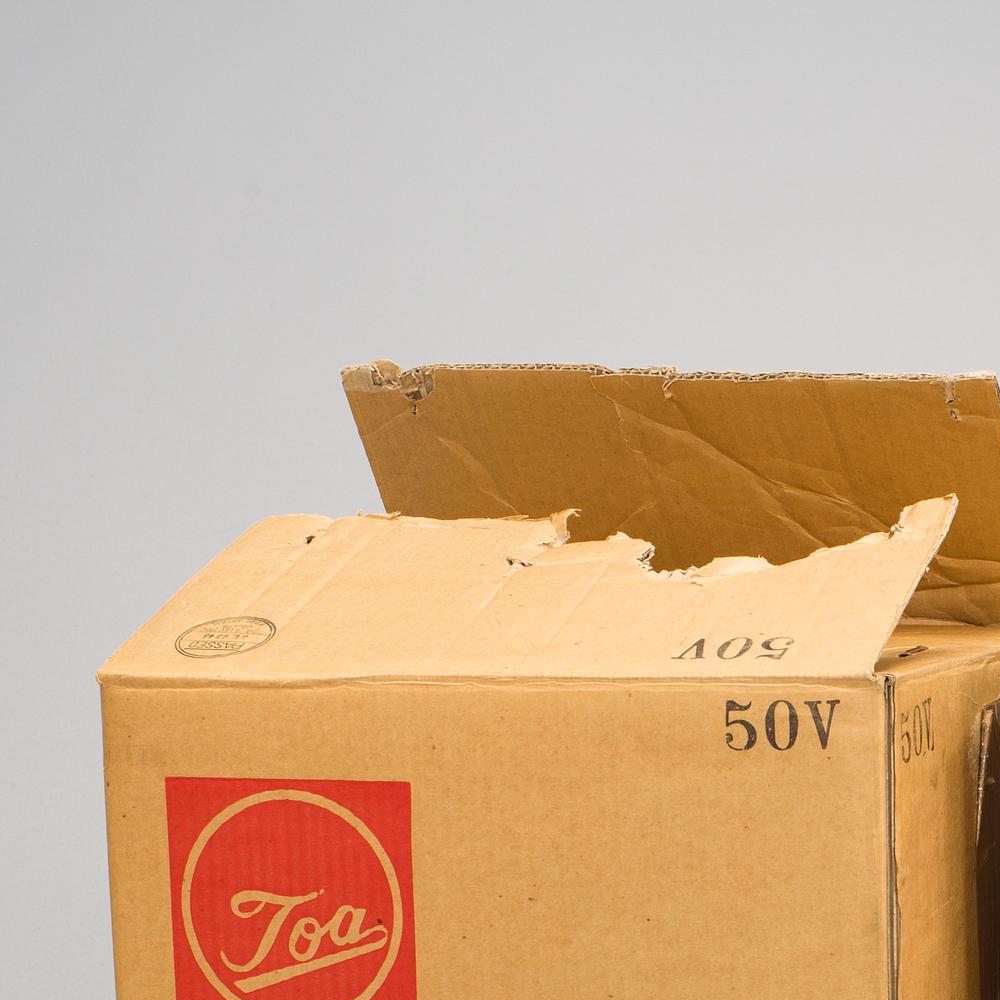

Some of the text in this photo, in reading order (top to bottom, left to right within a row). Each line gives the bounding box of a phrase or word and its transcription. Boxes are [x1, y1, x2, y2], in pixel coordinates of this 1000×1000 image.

[671, 636, 795, 660] 50V
[725, 699, 841, 751] 50V
[901, 697, 935, 763] 50V
[219, 888, 387, 993] Toa
